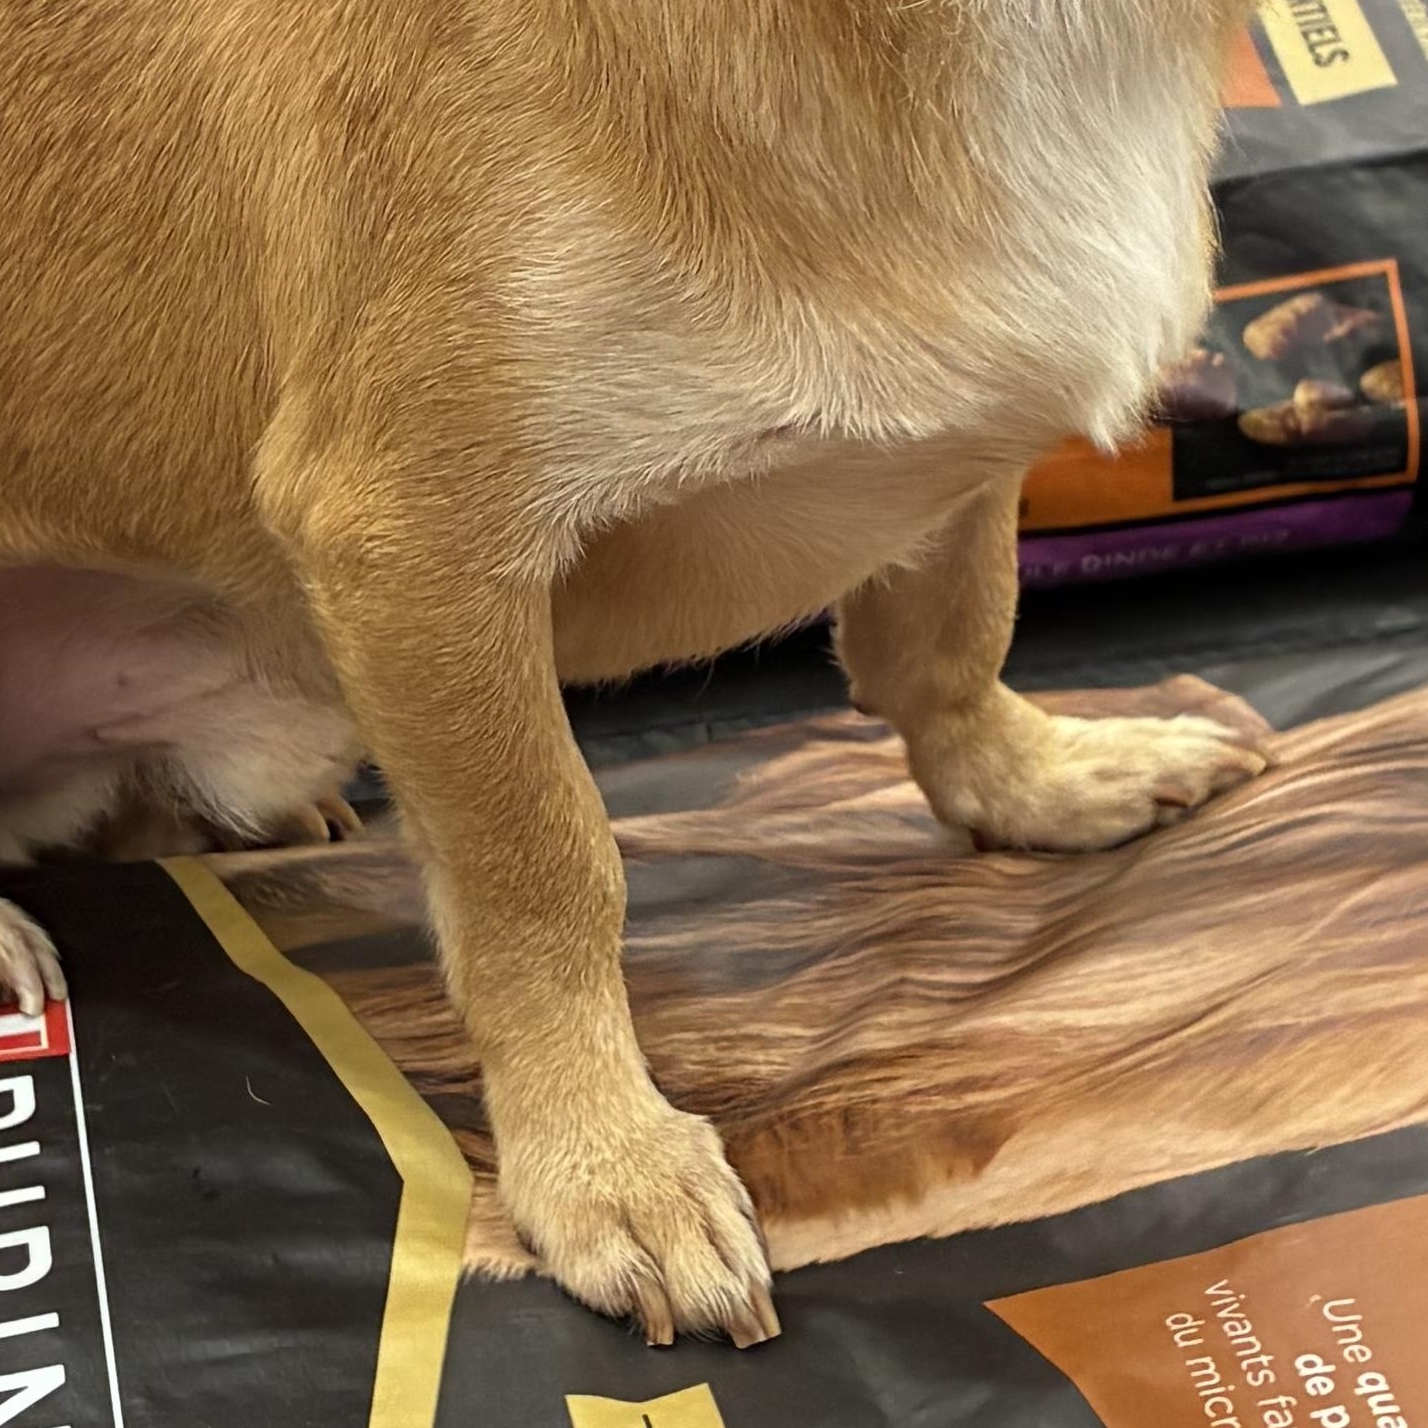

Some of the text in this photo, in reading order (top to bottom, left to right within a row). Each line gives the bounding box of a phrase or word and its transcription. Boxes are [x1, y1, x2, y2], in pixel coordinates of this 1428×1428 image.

[1165, 1311, 1206, 1350] du
[1203, 1278, 1278, 1388] vivants
[1321, 1296, 1373, 1365] Une
[1293, 1352, 1337, 1398] de
